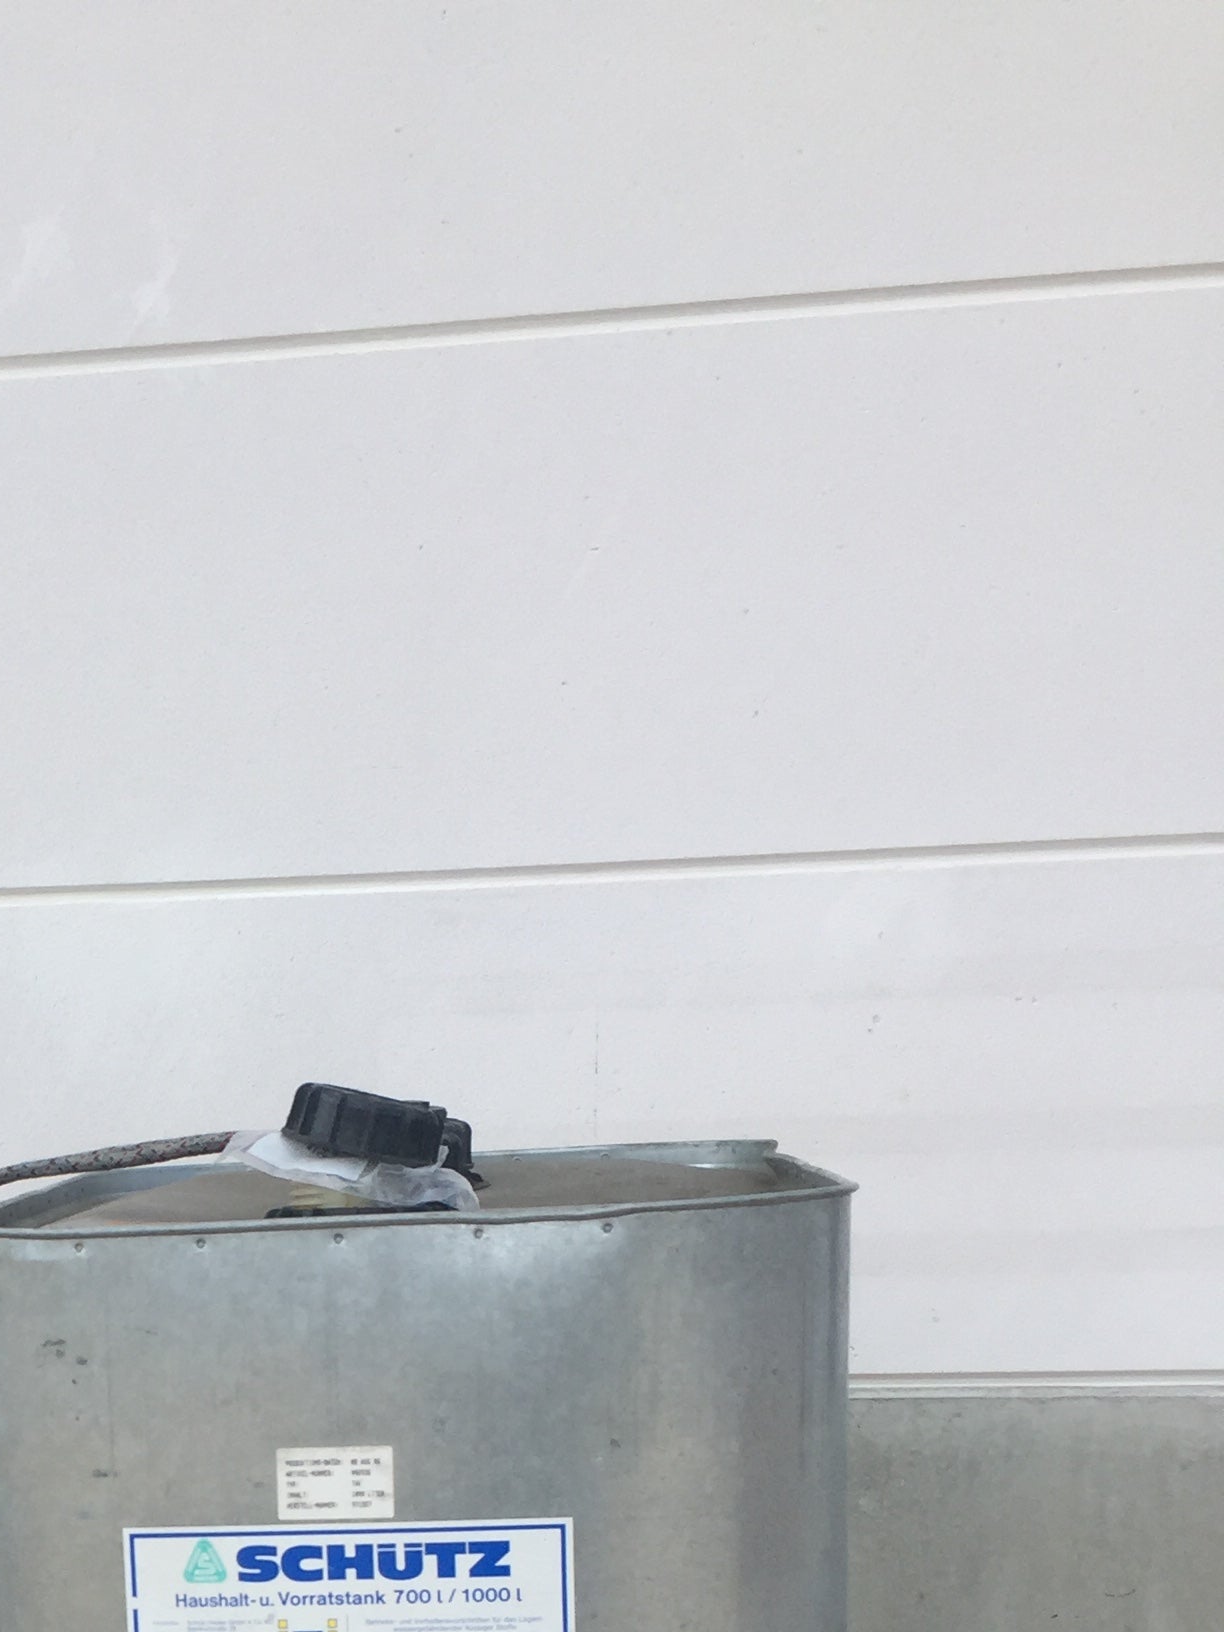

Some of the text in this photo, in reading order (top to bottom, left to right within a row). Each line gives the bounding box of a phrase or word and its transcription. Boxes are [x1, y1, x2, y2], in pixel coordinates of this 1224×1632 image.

[236, 1540, 511, 1583] SCHÜTZ
[277, 1590, 386, 1606] Vorratstank
[394, 1589, 431, 1604] 700
[462, 1587, 511, 1603] 1000
